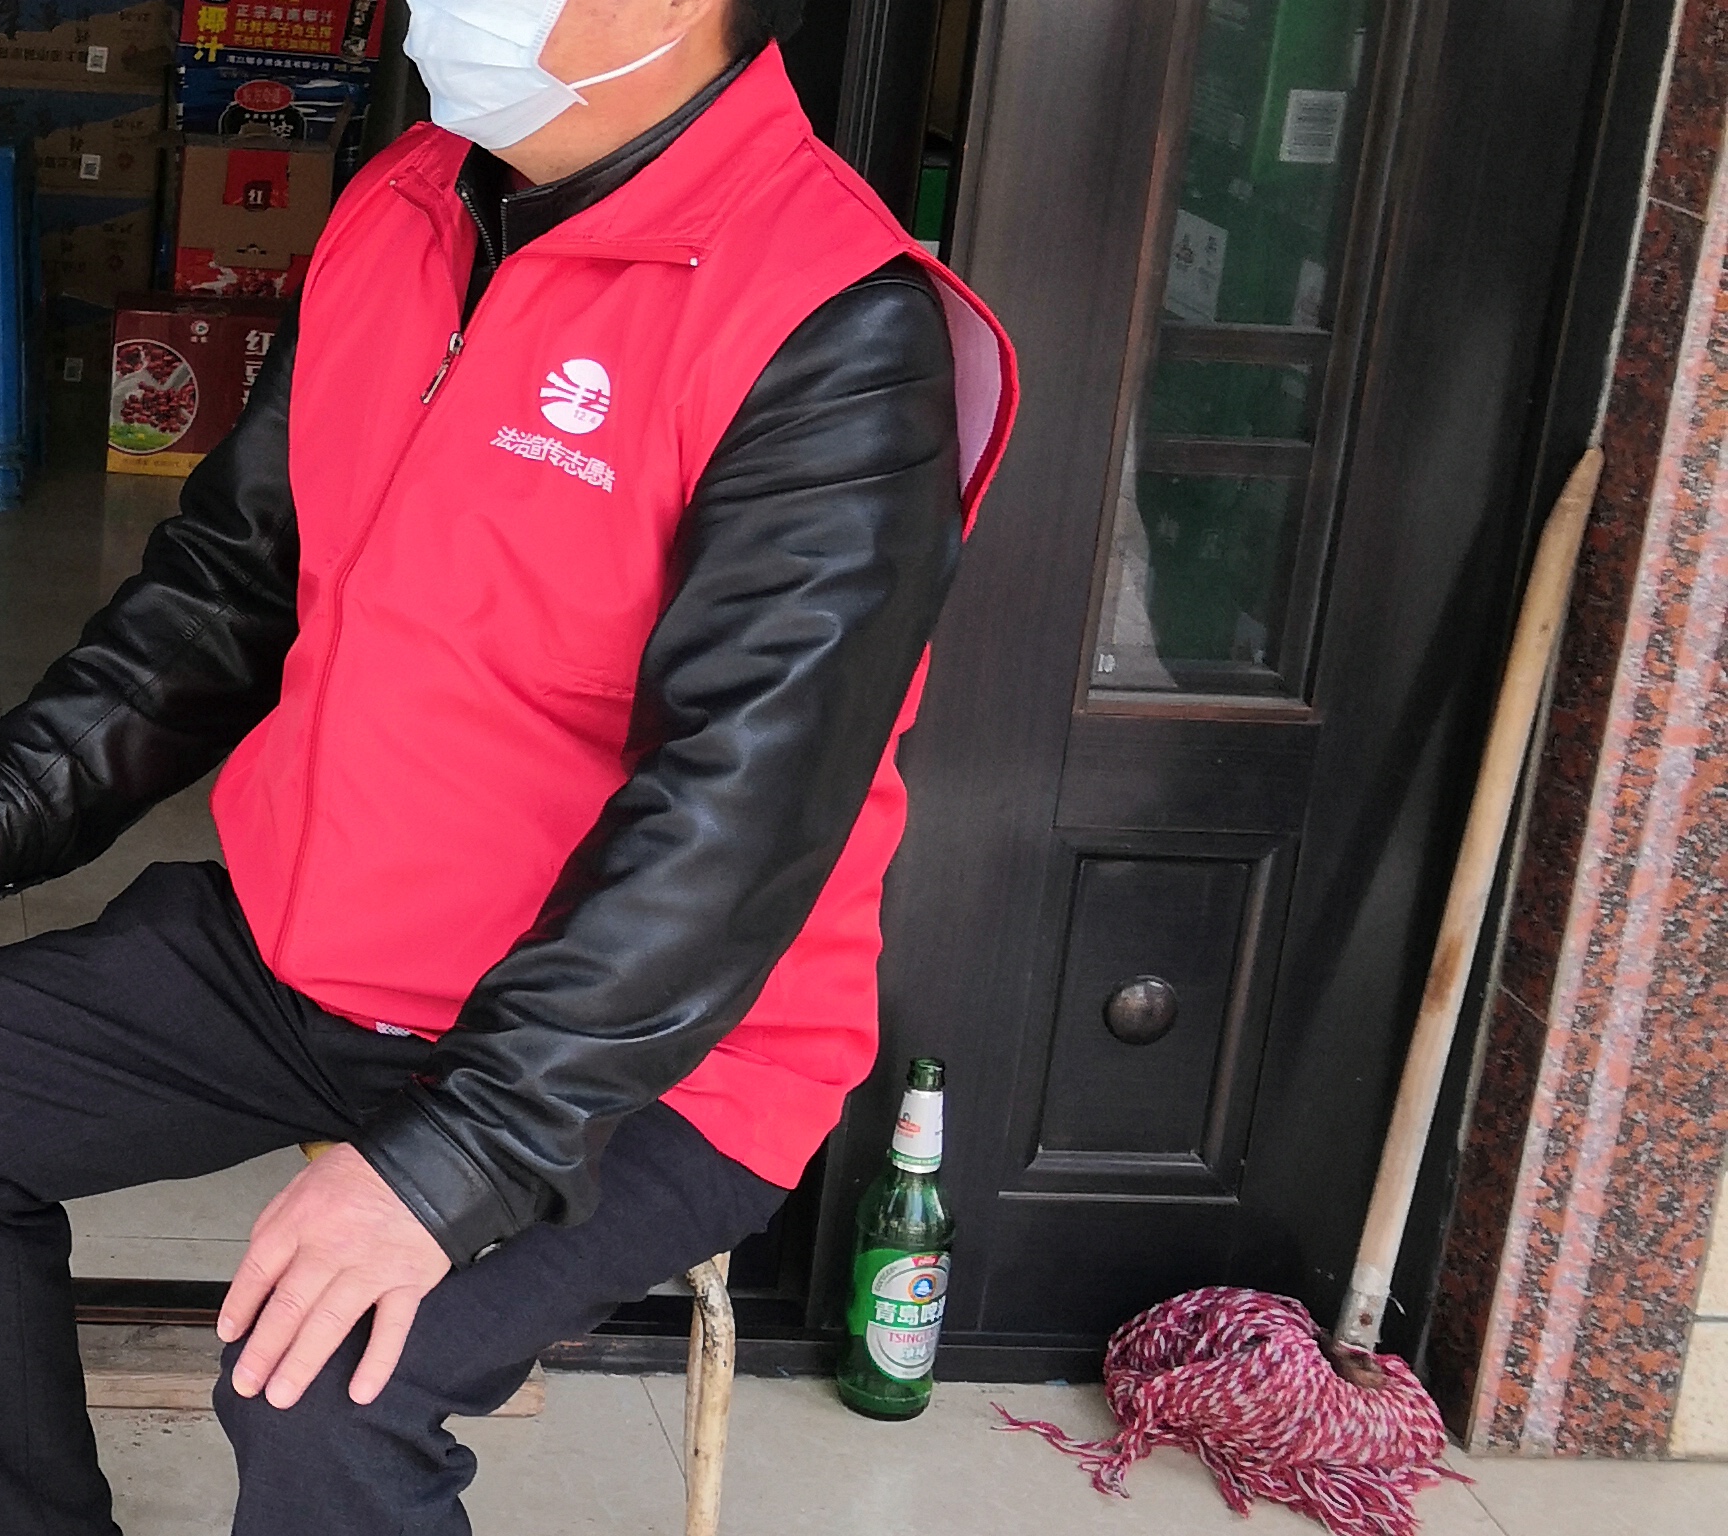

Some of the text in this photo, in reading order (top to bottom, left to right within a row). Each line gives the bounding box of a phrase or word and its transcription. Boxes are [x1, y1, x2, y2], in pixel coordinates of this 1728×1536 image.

[242, 329, 276, 410] 红豆
[490, 426, 615, 493] 法治宣传志愿者
